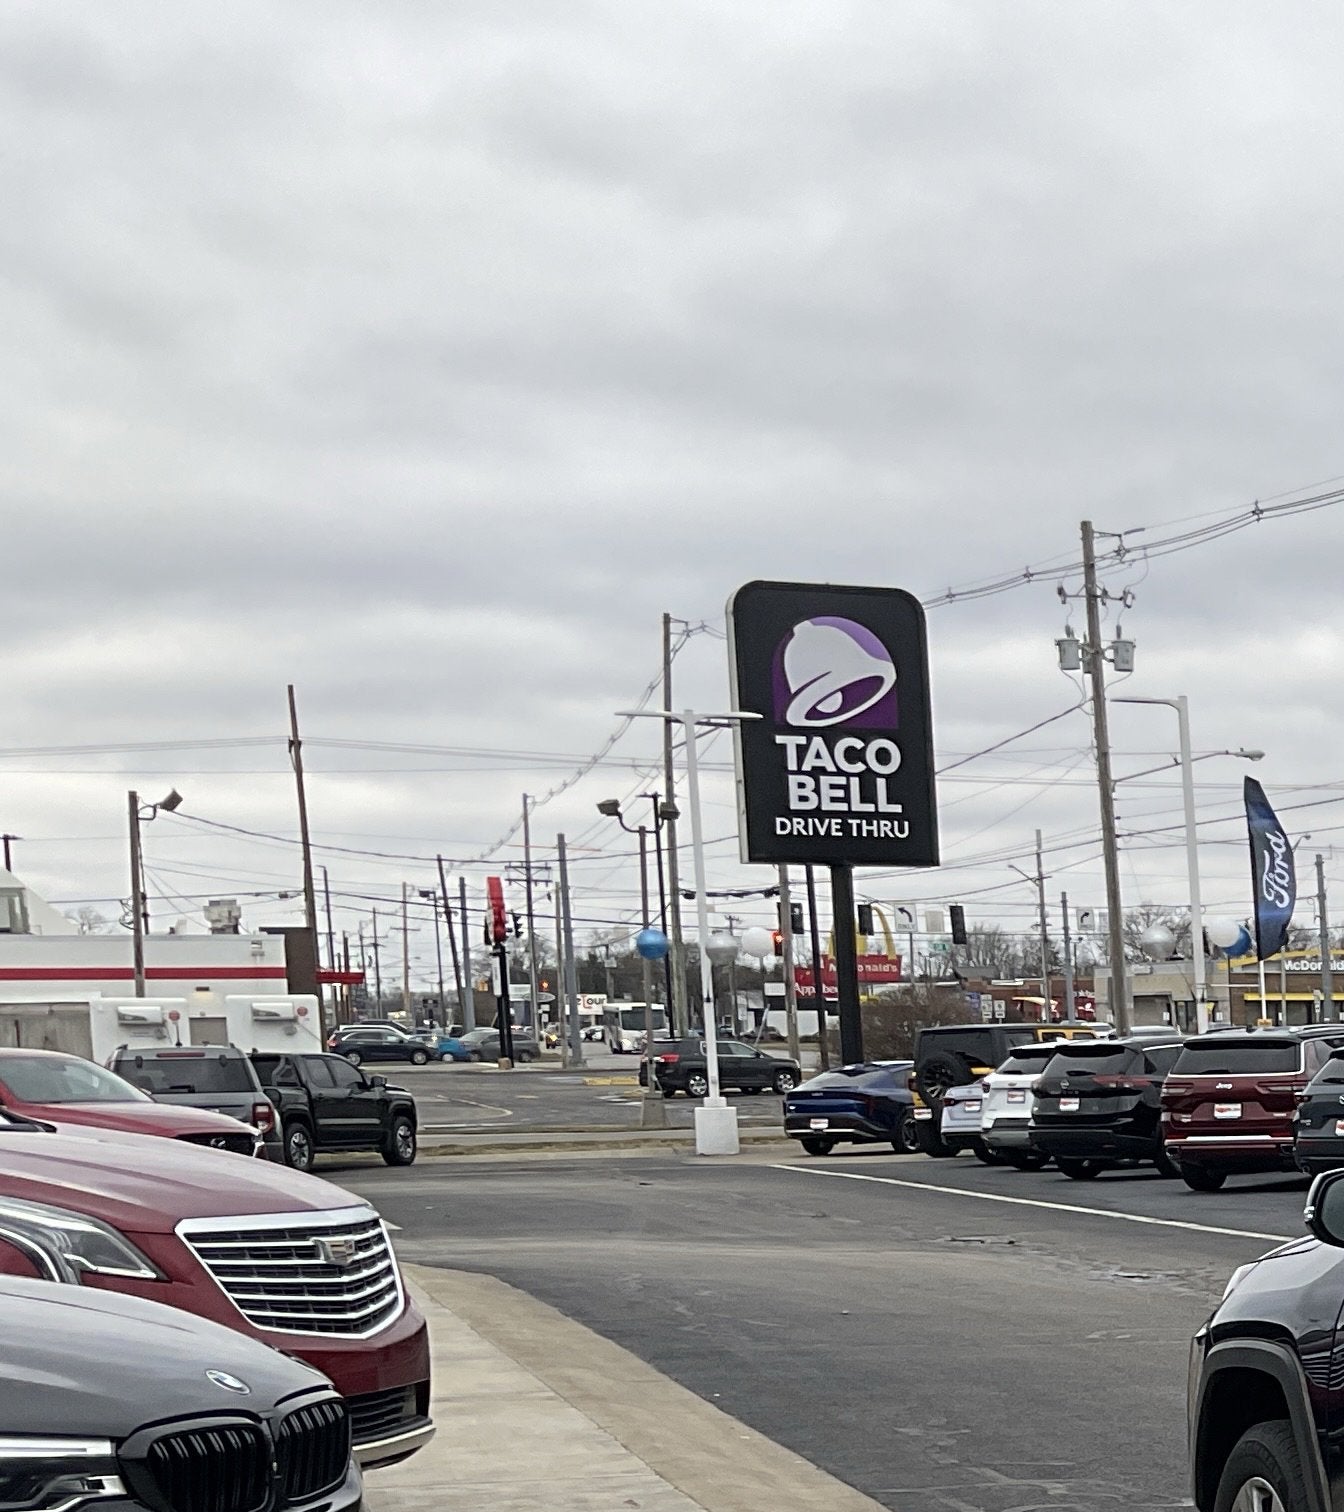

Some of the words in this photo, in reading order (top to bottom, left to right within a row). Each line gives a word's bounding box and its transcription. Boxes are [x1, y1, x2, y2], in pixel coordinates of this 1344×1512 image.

[775, 735, 902, 775] TACO
[787, 774, 903, 813] BELL
[775, 817, 843, 836] DRIVE
[847, 819, 910, 838] THRU
[1263, 830, 1290, 908] Ford
